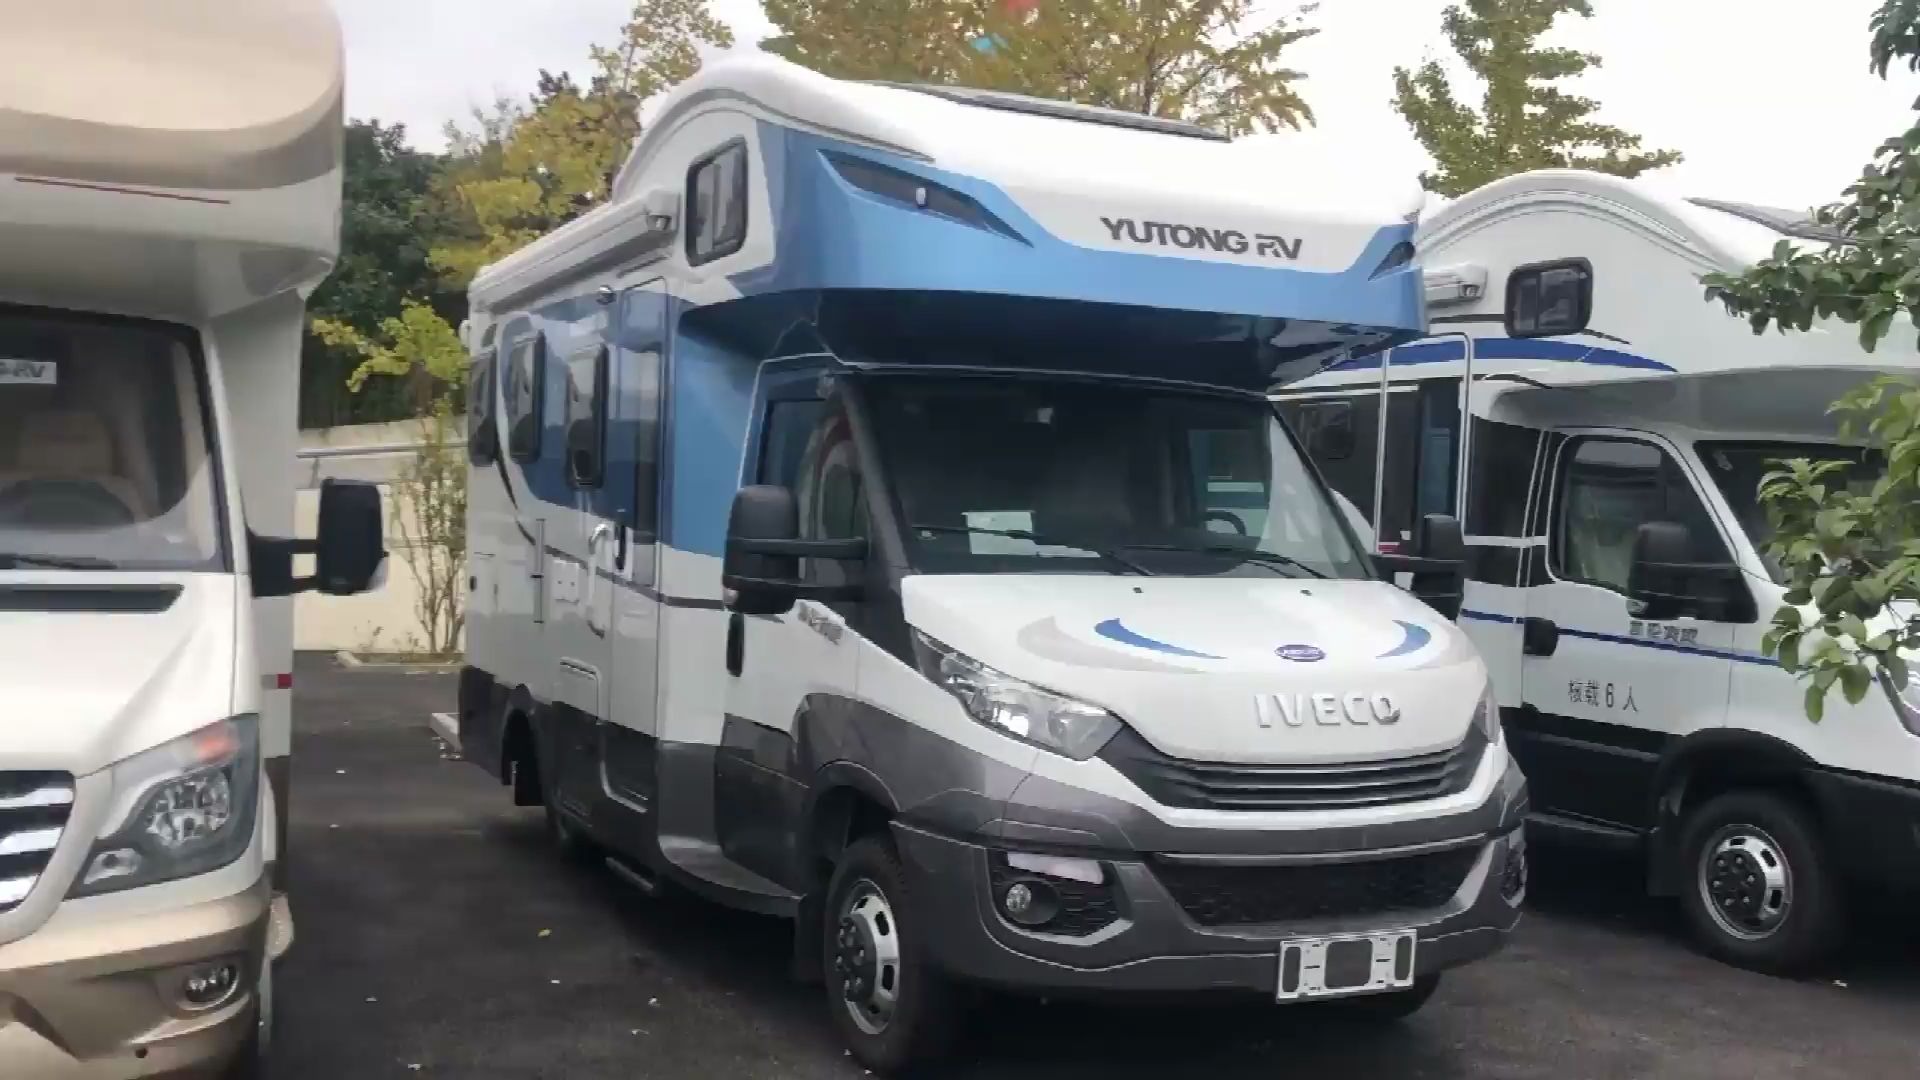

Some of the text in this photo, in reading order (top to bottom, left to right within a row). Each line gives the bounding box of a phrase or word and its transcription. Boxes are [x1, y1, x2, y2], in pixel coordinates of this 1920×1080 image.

[1100, 216, 1303, 260] YUTONG RV
[1255, 693, 1401, 728] IVECO
